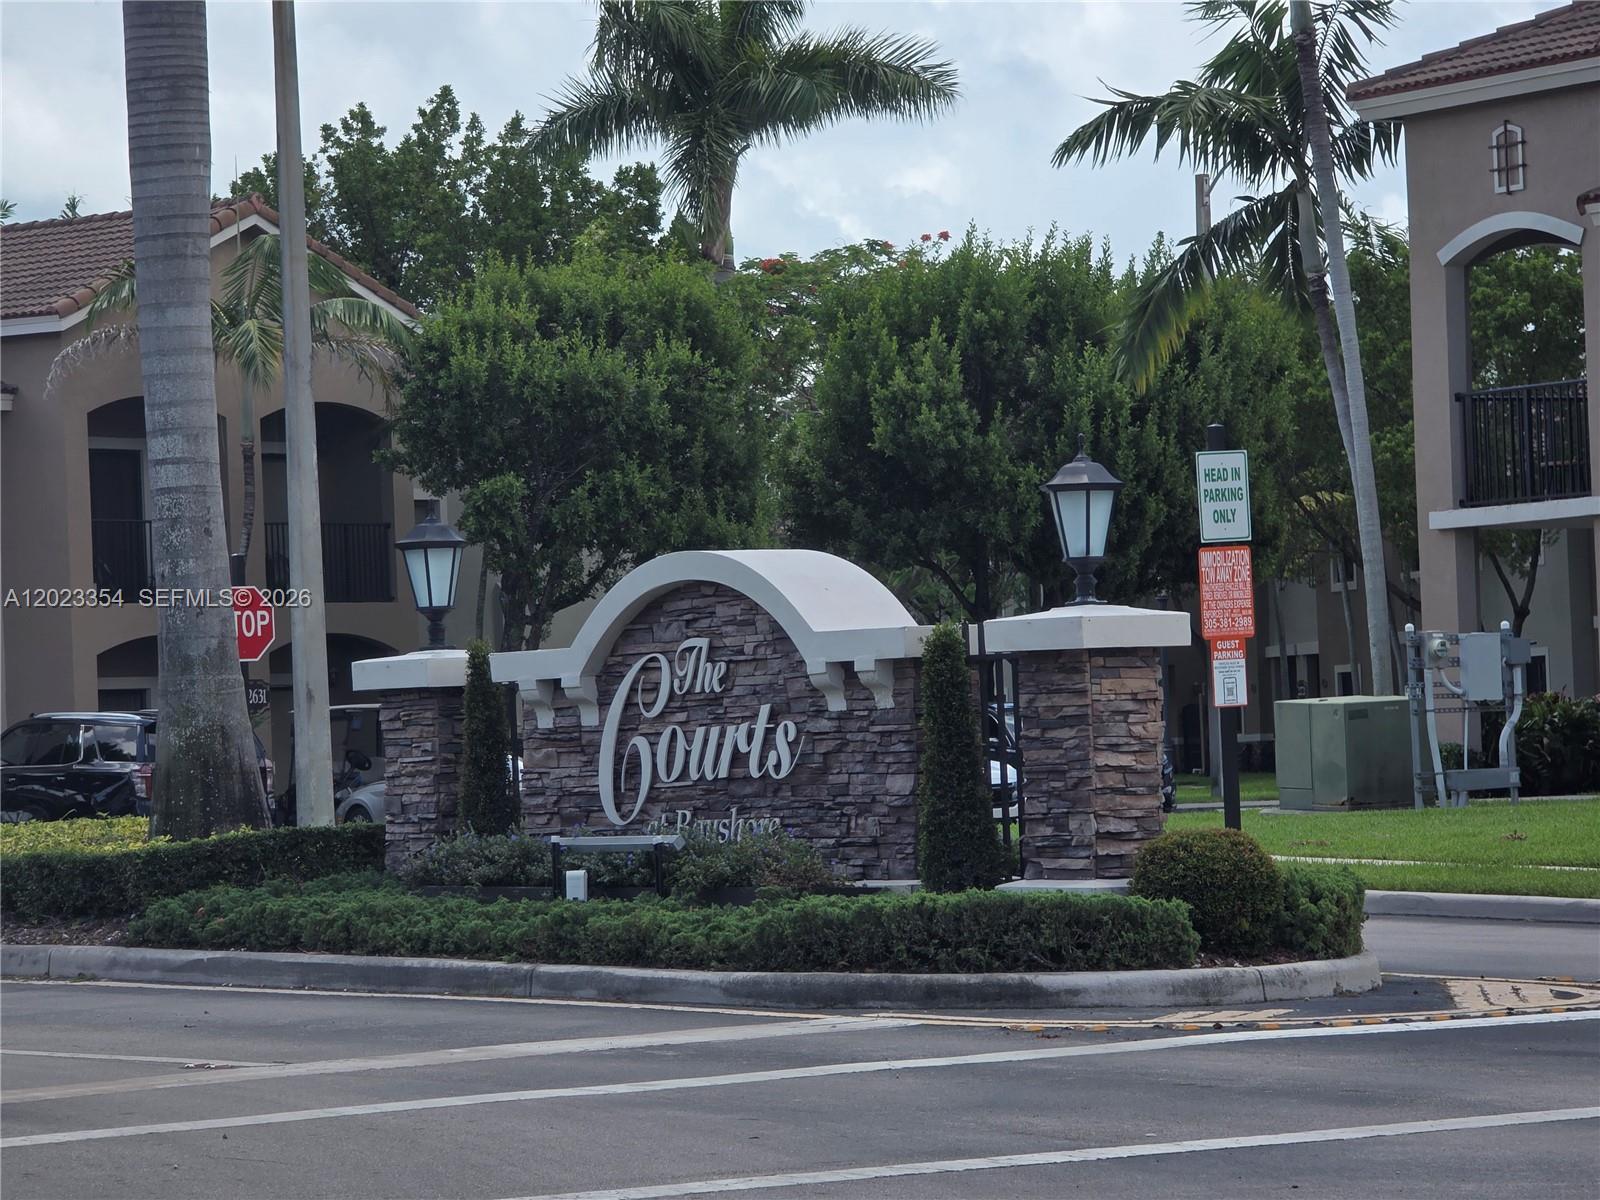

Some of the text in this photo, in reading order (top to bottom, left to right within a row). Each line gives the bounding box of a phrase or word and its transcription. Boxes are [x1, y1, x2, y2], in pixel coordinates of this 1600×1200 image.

[1204, 467, 1241, 483] HEAD IN
[1203, 487, 1244, 503] PARKING
[1213, 508, 1237, 524] ONLY
[1201, 549, 1250, 567] IMMOBILIZATION
[1201, 565, 1251, 584] TOW AWAY ZONE
[1209, 600, 1217, 610] THE
[1234, 599, 1252, 608] EXPENSE
[1203, 609, 1223, 619] ENFORCED
[233, 610, 270, 638] TOP
[1216, 640, 1240, 650] GUEST
[1213, 650, 1244, 660] PARKING
[673, 637, 728, 696] The
[248, 688, 267, 704] 2631
[598, 652, 806, 826] Courts
